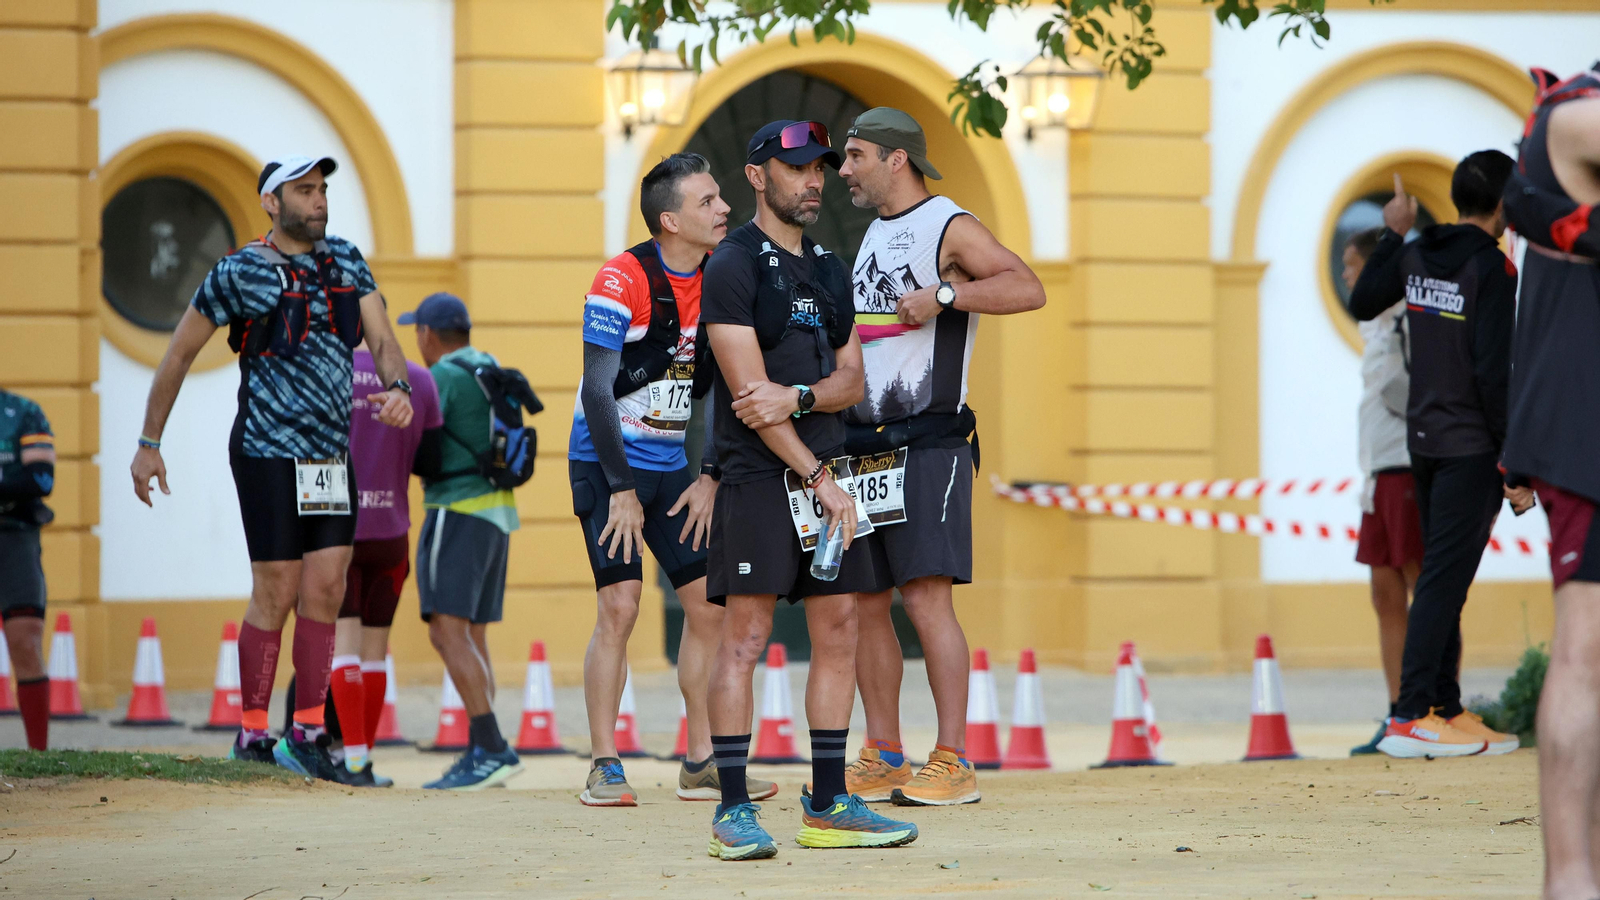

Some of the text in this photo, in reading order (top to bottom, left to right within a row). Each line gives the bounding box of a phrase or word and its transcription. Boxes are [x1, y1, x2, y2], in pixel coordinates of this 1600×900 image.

[1405, 285, 1465, 314] PALACIEGO
[668, 384, 693, 409] 173
[863, 456, 892, 472] Sherry
[315, 468, 333, 491] 49
[857, 474, 888, 503] 185
[251, 641, 278, 706] Kalenji
